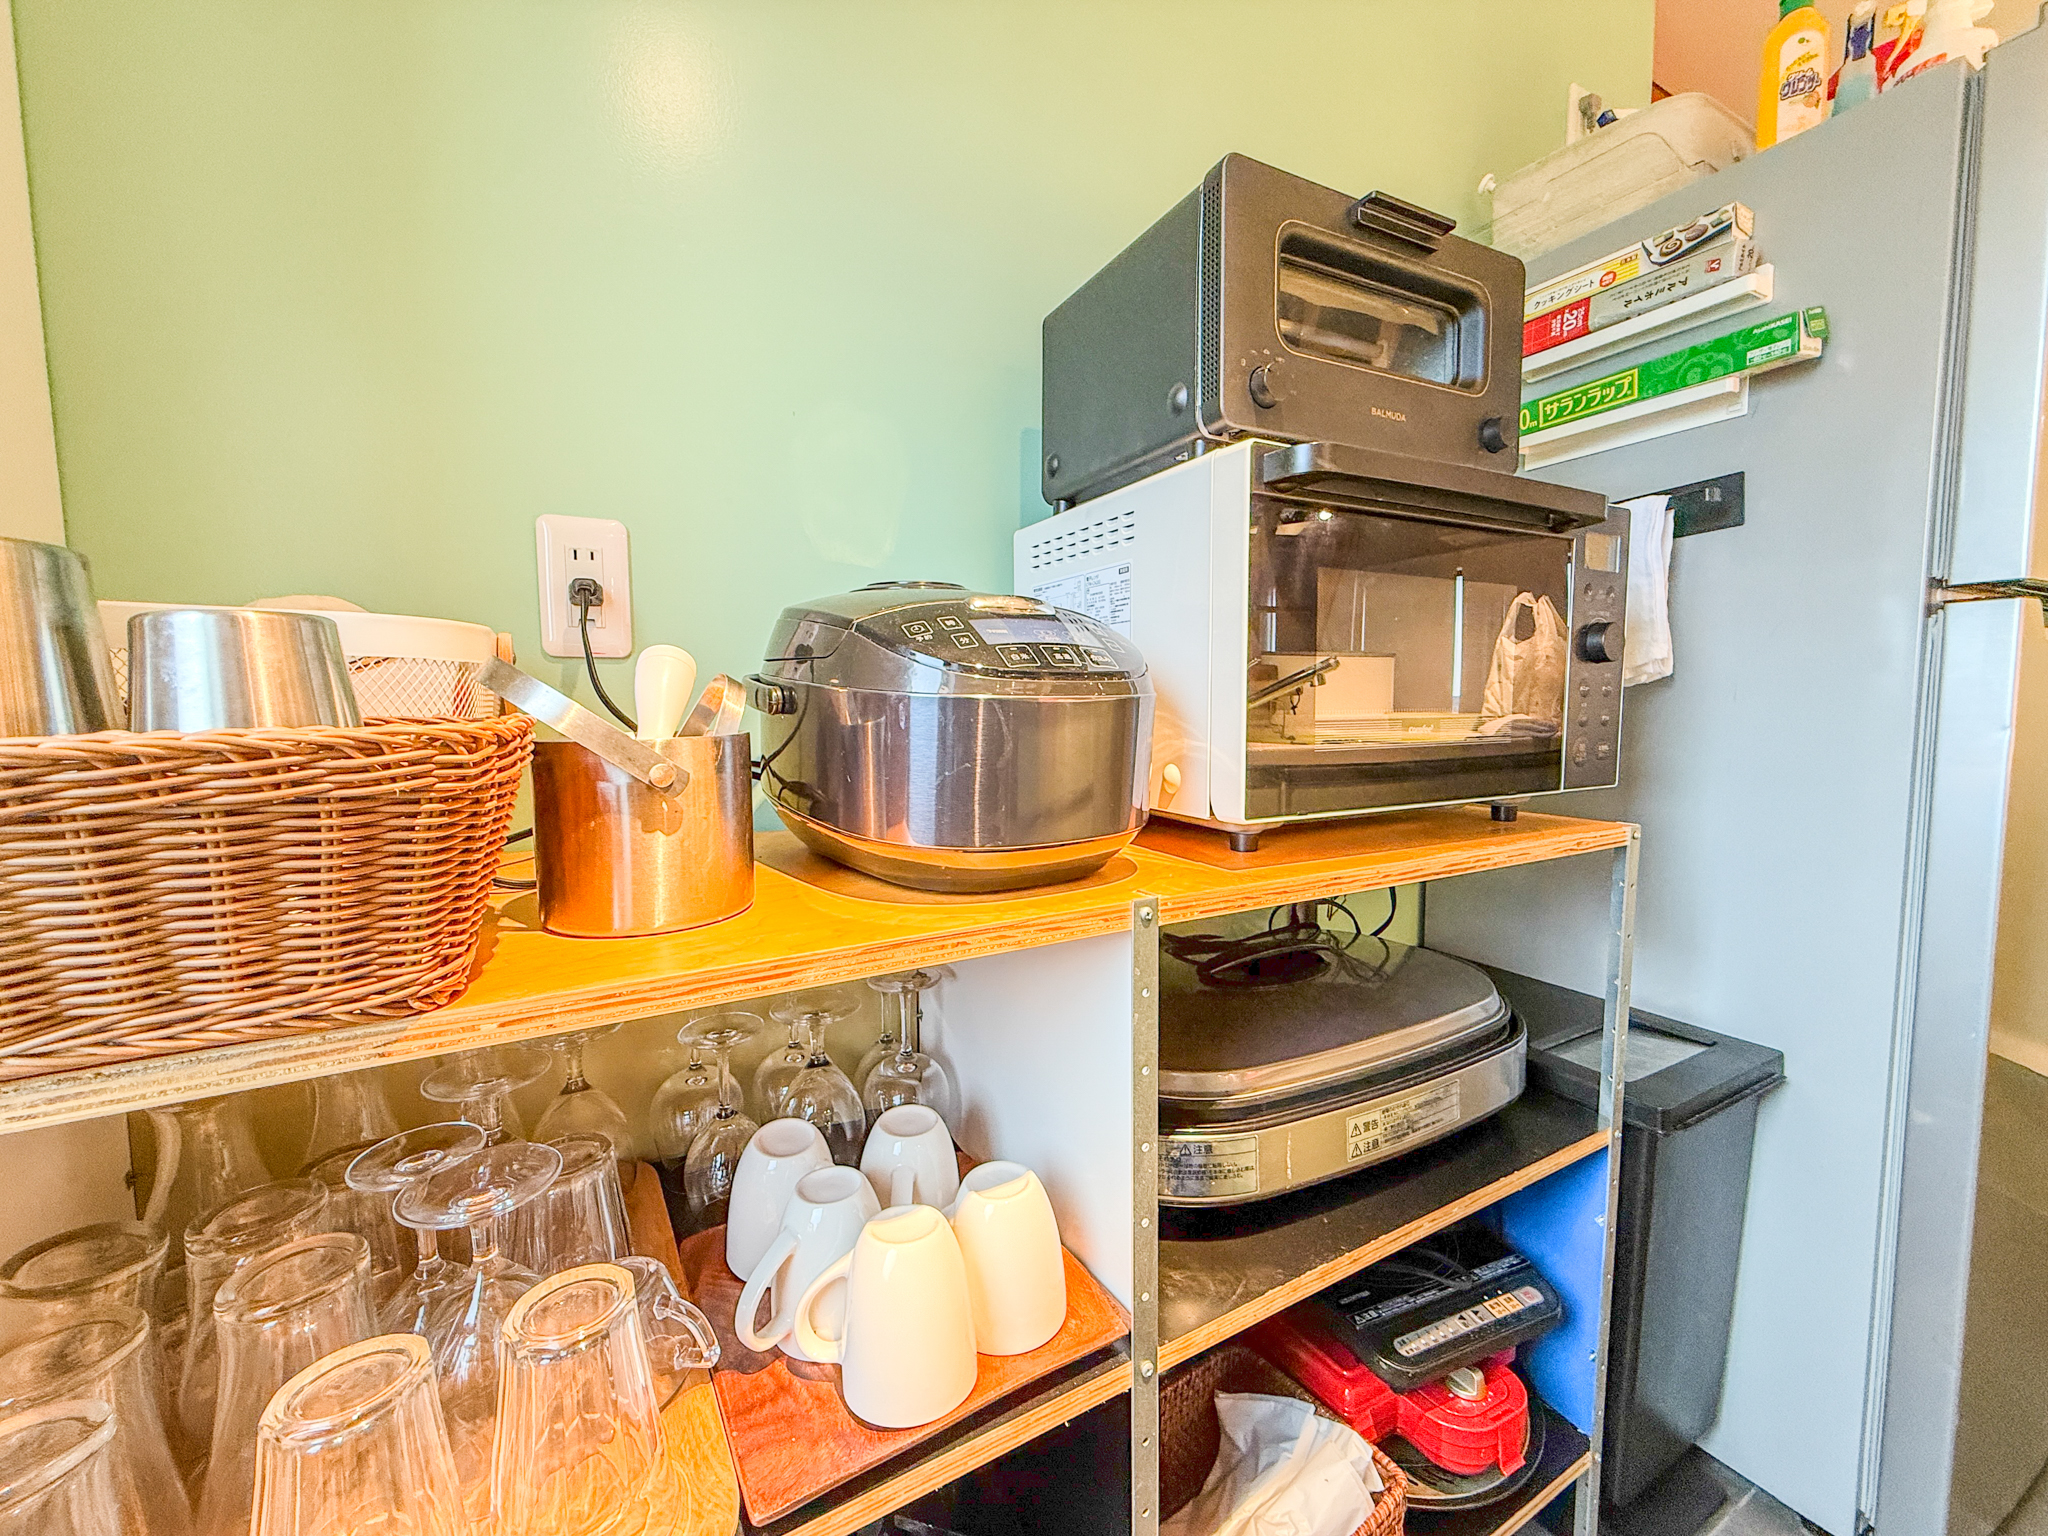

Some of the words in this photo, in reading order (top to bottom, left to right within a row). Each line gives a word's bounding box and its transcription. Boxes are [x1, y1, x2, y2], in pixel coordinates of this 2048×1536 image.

[1534, 279, 1595, 310] クッキングシート
[1623, 276, 1688, 308] アルミホイル
[1544, 375, 1632, 420] サランラップ
[1371, 406, 1407, 422] BALMUDA
[1362, 1119, 1379, 1133] 警告
[1193, 1144, 1213, 1155] 注意
[1363, 1138, 1380, 1153] 注意
